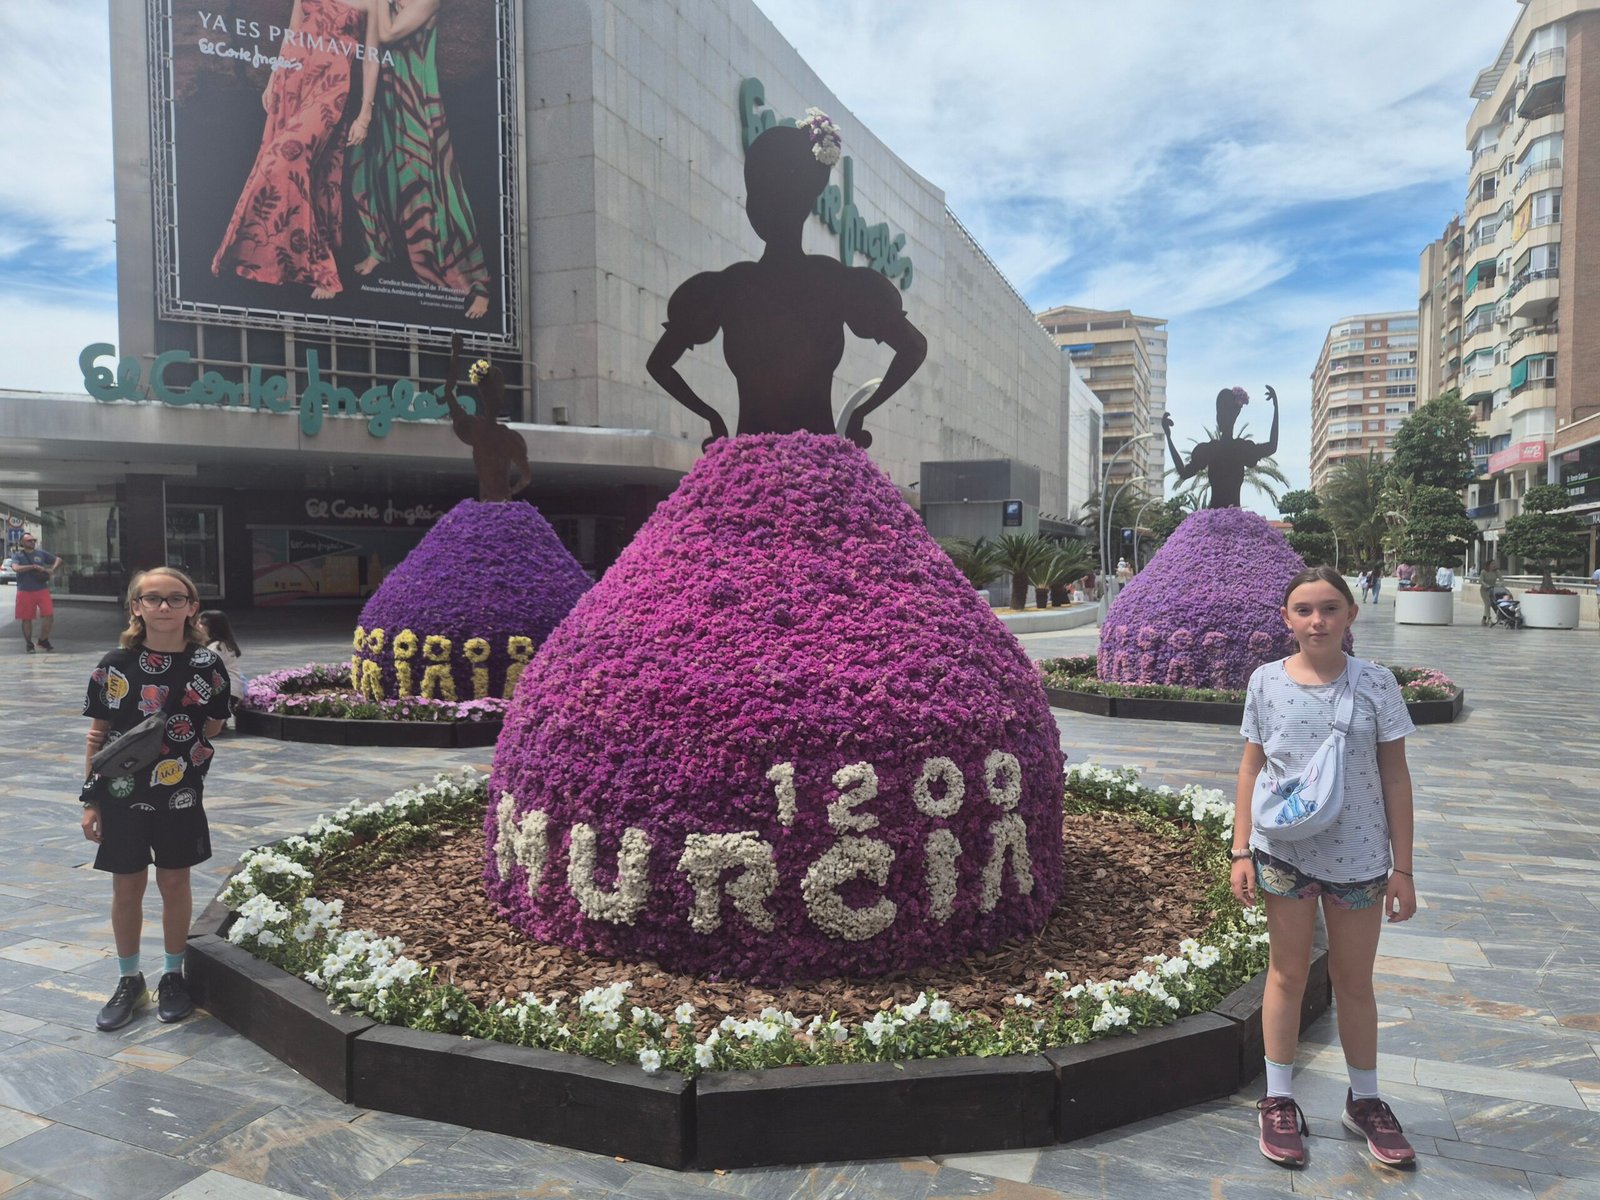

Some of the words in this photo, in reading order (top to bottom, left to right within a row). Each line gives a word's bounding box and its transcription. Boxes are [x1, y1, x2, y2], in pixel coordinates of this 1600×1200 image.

[198, 11, 227, 33] YA
[236, 18, 261, 38] ES
[269, 25, 395, 67] PRIMAVERA
[198, 38, 215, 55] El
[215, 42, 252, 62] Corte
[252, 45, 303, 71] Inglés
[78, 342, 145, 400] El
[150, 350, 290, 412] Corte
[301, 348, 476, 437] Inglés
[306, 499, 329, 518] El
[331, 499, 379, 519] Corte
[384, 499, 446, 525] Inglés
[193, 674, 212, 693] CHICA
[490, 790, 1035, 942] MURCIA
